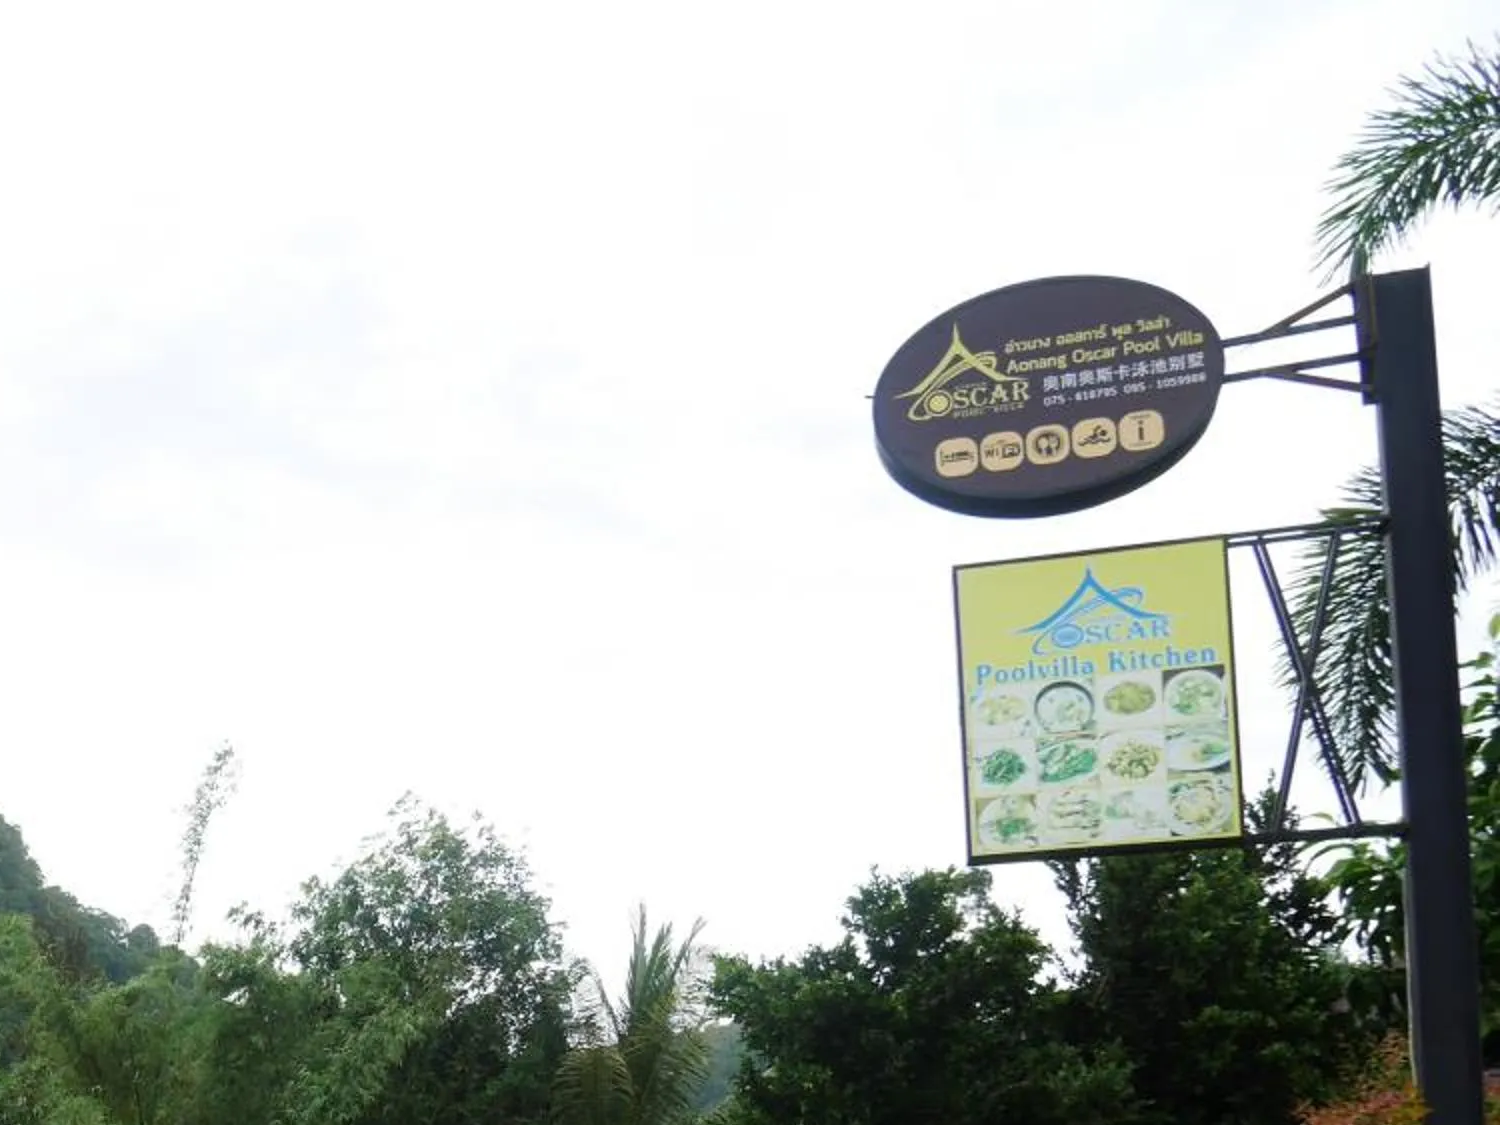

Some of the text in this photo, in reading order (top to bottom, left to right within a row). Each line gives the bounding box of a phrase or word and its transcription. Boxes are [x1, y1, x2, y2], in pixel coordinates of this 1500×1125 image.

[1007, 330, 1204, 375] Aonang Oscar Pool Villa
[924, 381, 1030, 417] OSCAR
[1052, 618, 1171, 648] OSCAR
[976, 647, 1216, 685] Poolvilla Kitchen
